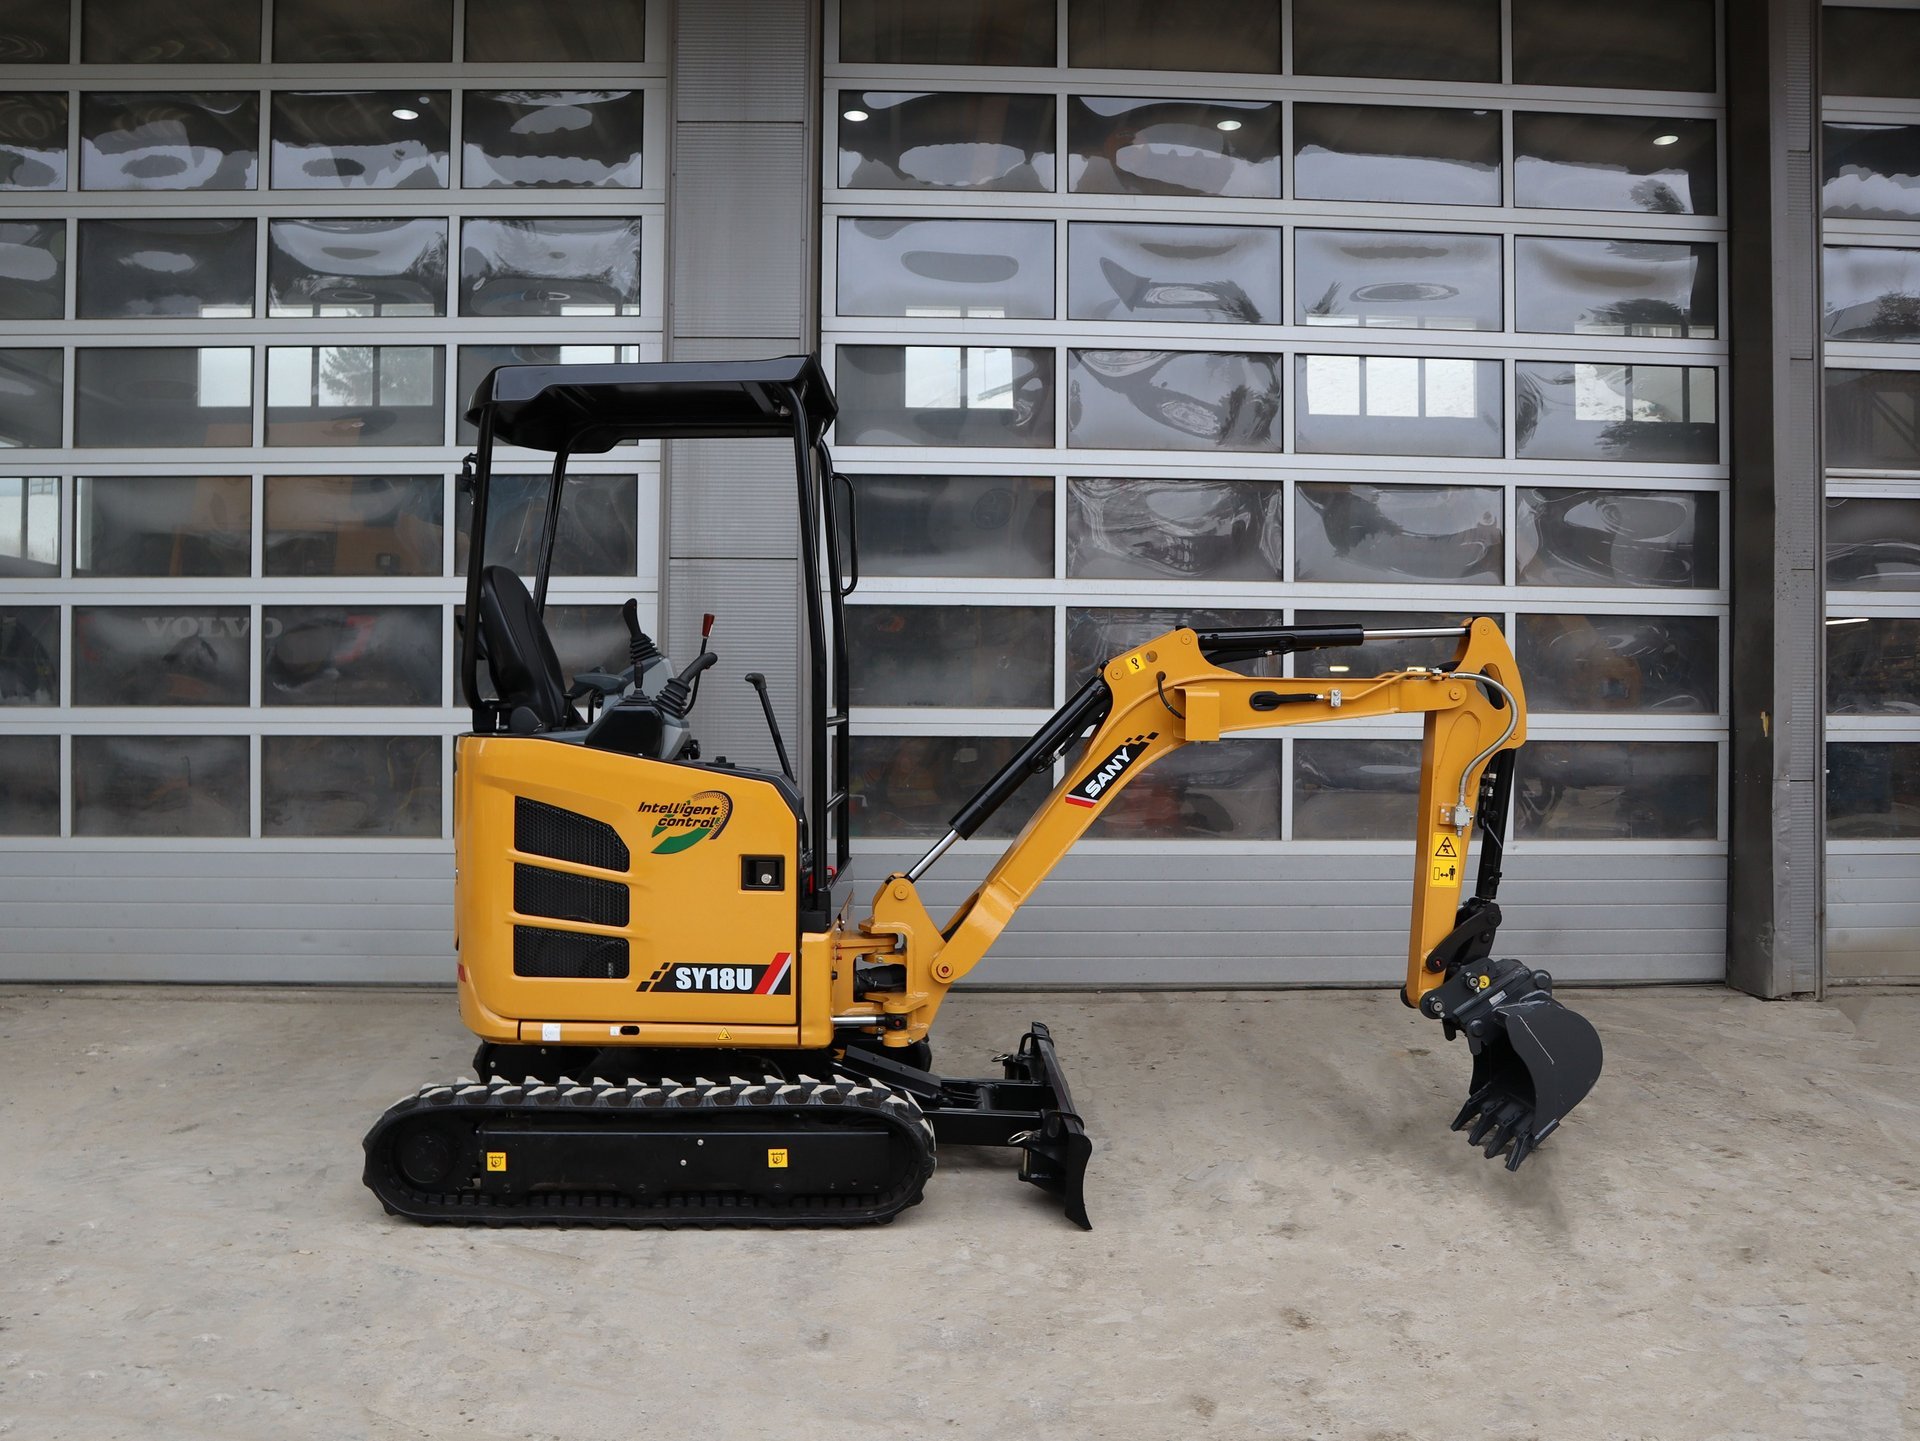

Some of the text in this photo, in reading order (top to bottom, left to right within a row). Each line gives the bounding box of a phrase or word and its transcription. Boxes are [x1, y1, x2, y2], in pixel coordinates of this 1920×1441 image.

[1085, 747, 1130, 797] SANY
[638, 801, 719, 817] Intelligent
[658, 816, 715, 828] control
[675, 967, 753, 990] SY18U
